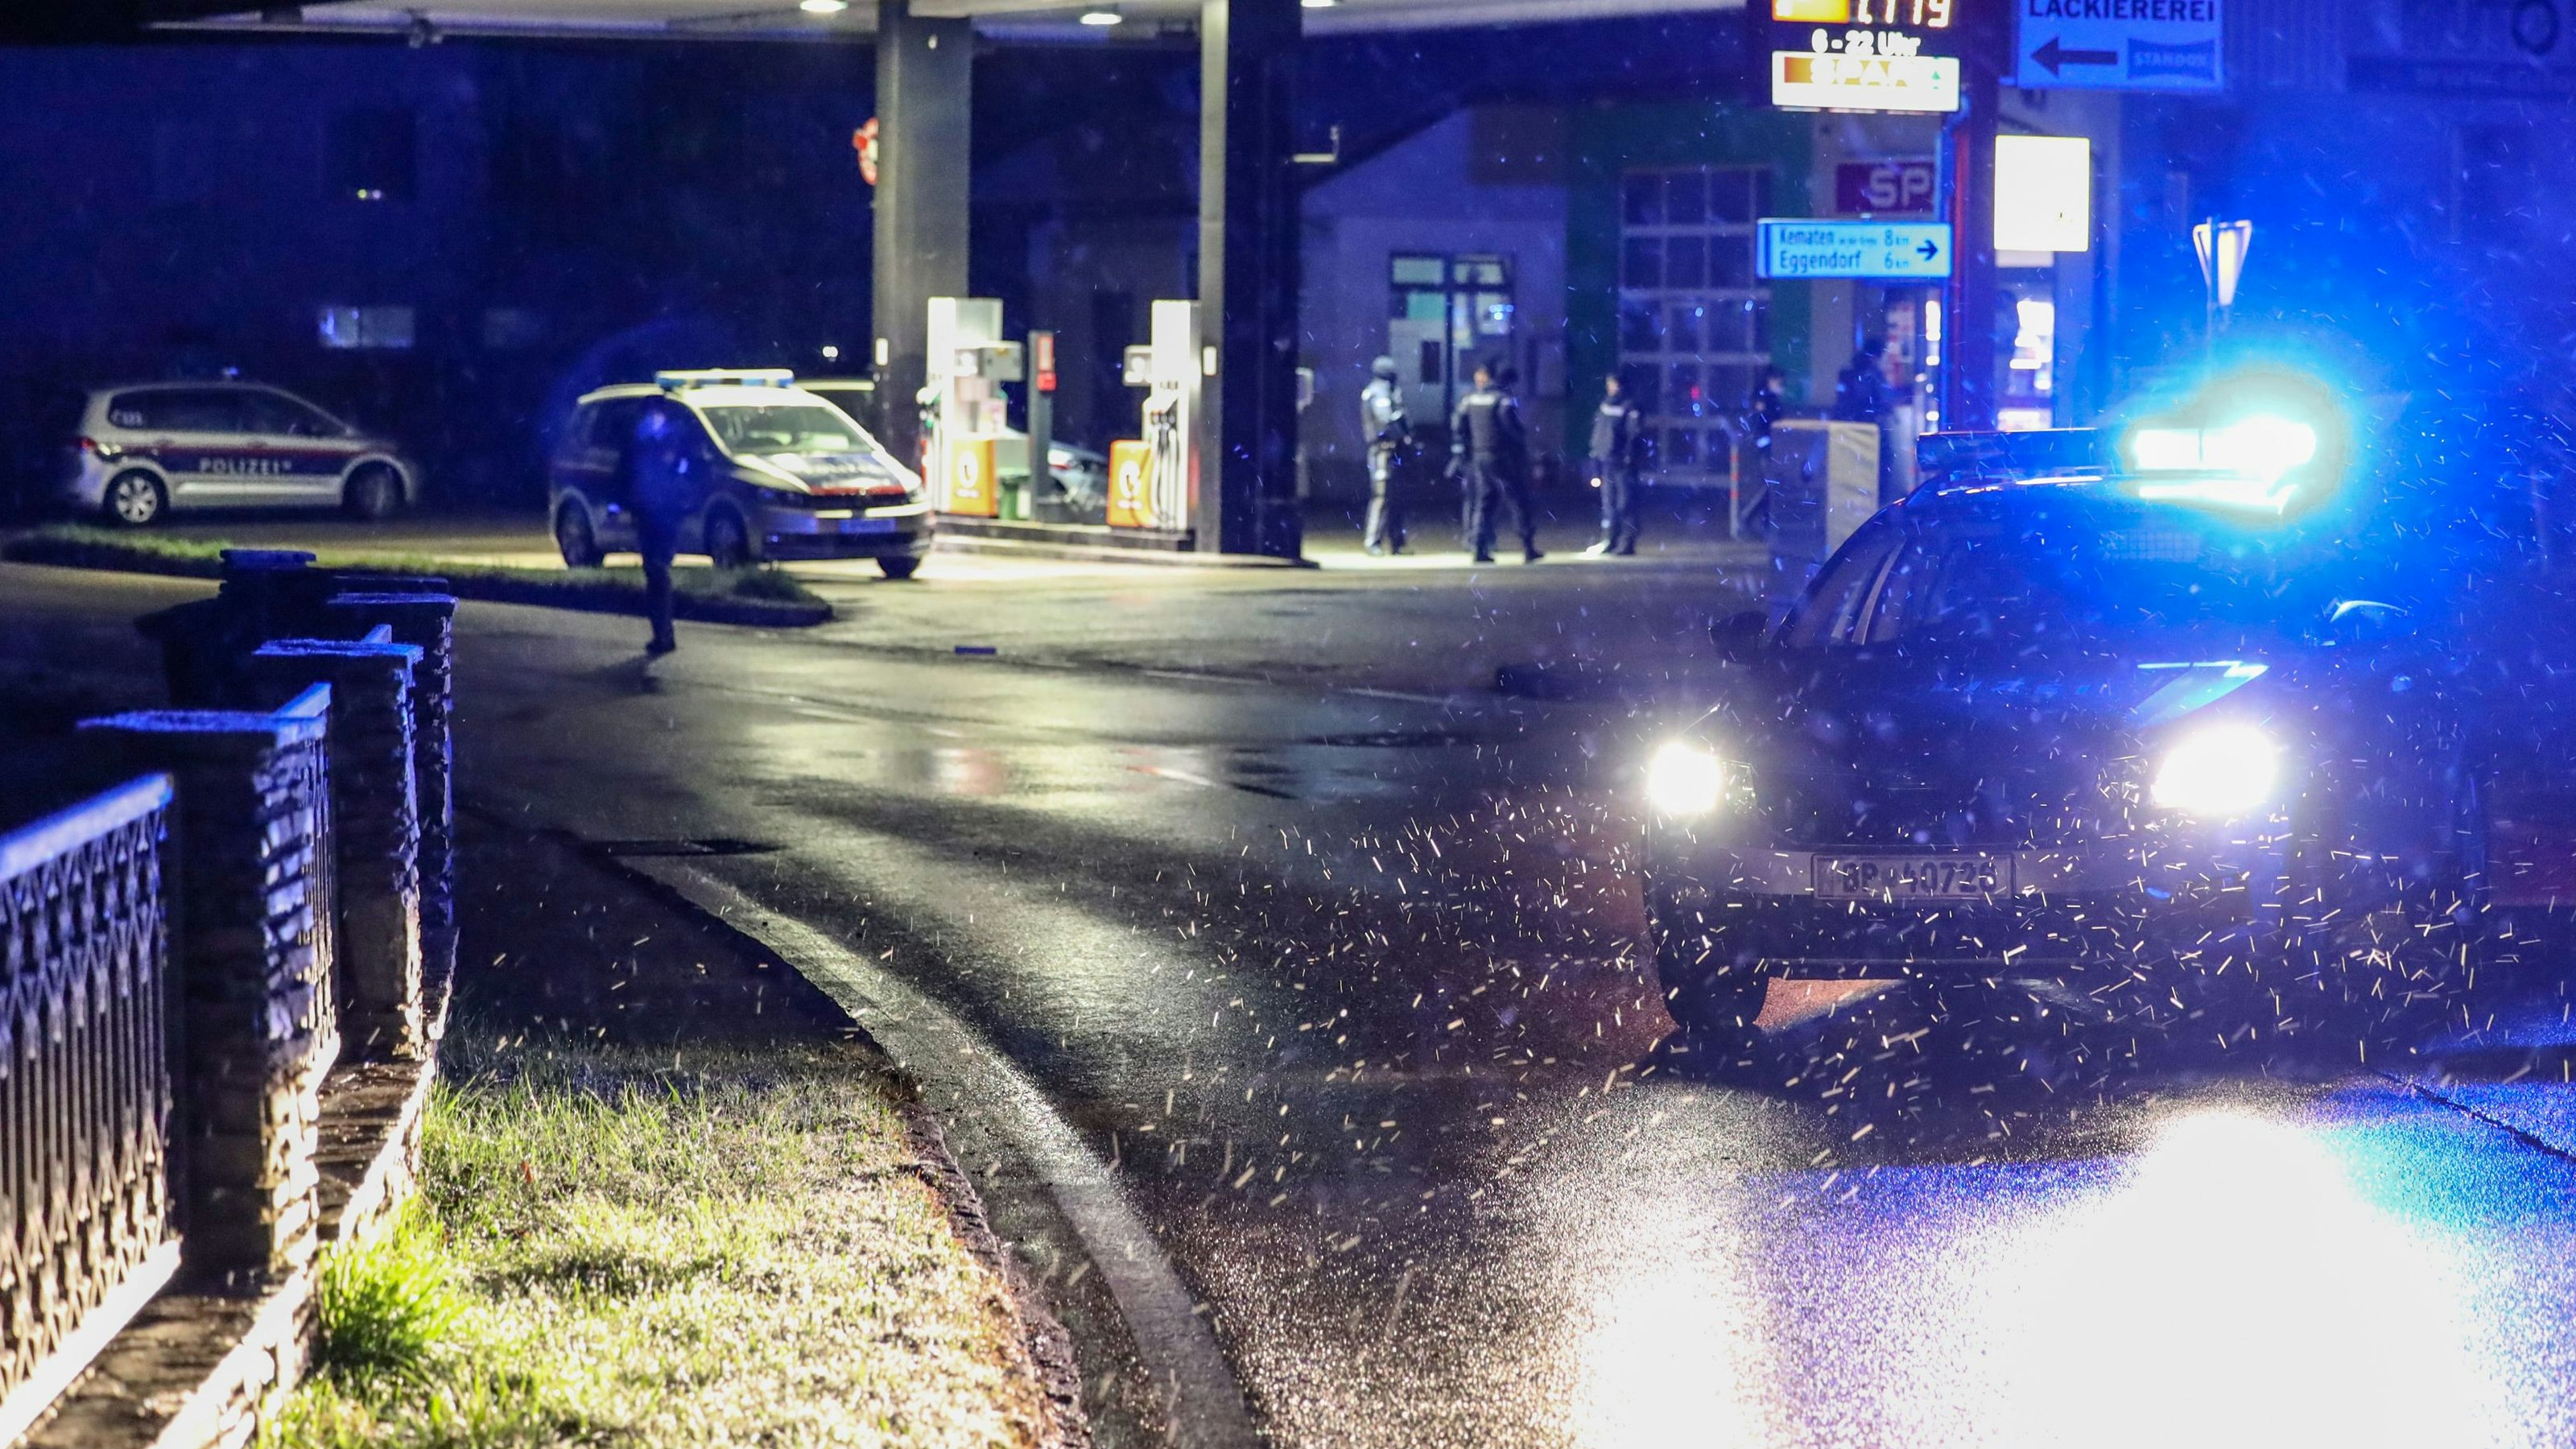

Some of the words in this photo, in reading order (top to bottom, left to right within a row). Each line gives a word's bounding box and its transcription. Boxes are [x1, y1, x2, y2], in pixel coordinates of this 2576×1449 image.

[2029, 0, 2214, 21] LACKIEREREI
[1811, 28, 1828, 53] 6
[1845, 30, 1875, 56] 22
[1877, 31, 1922, 56] Uhr
[1780, 229, 1835, 245] Kematen
[1885, 229, 1893, 246] 8
[1780, 250, 1861, 273] Eggendorf
[1885, 252, 1893, 270] 6
